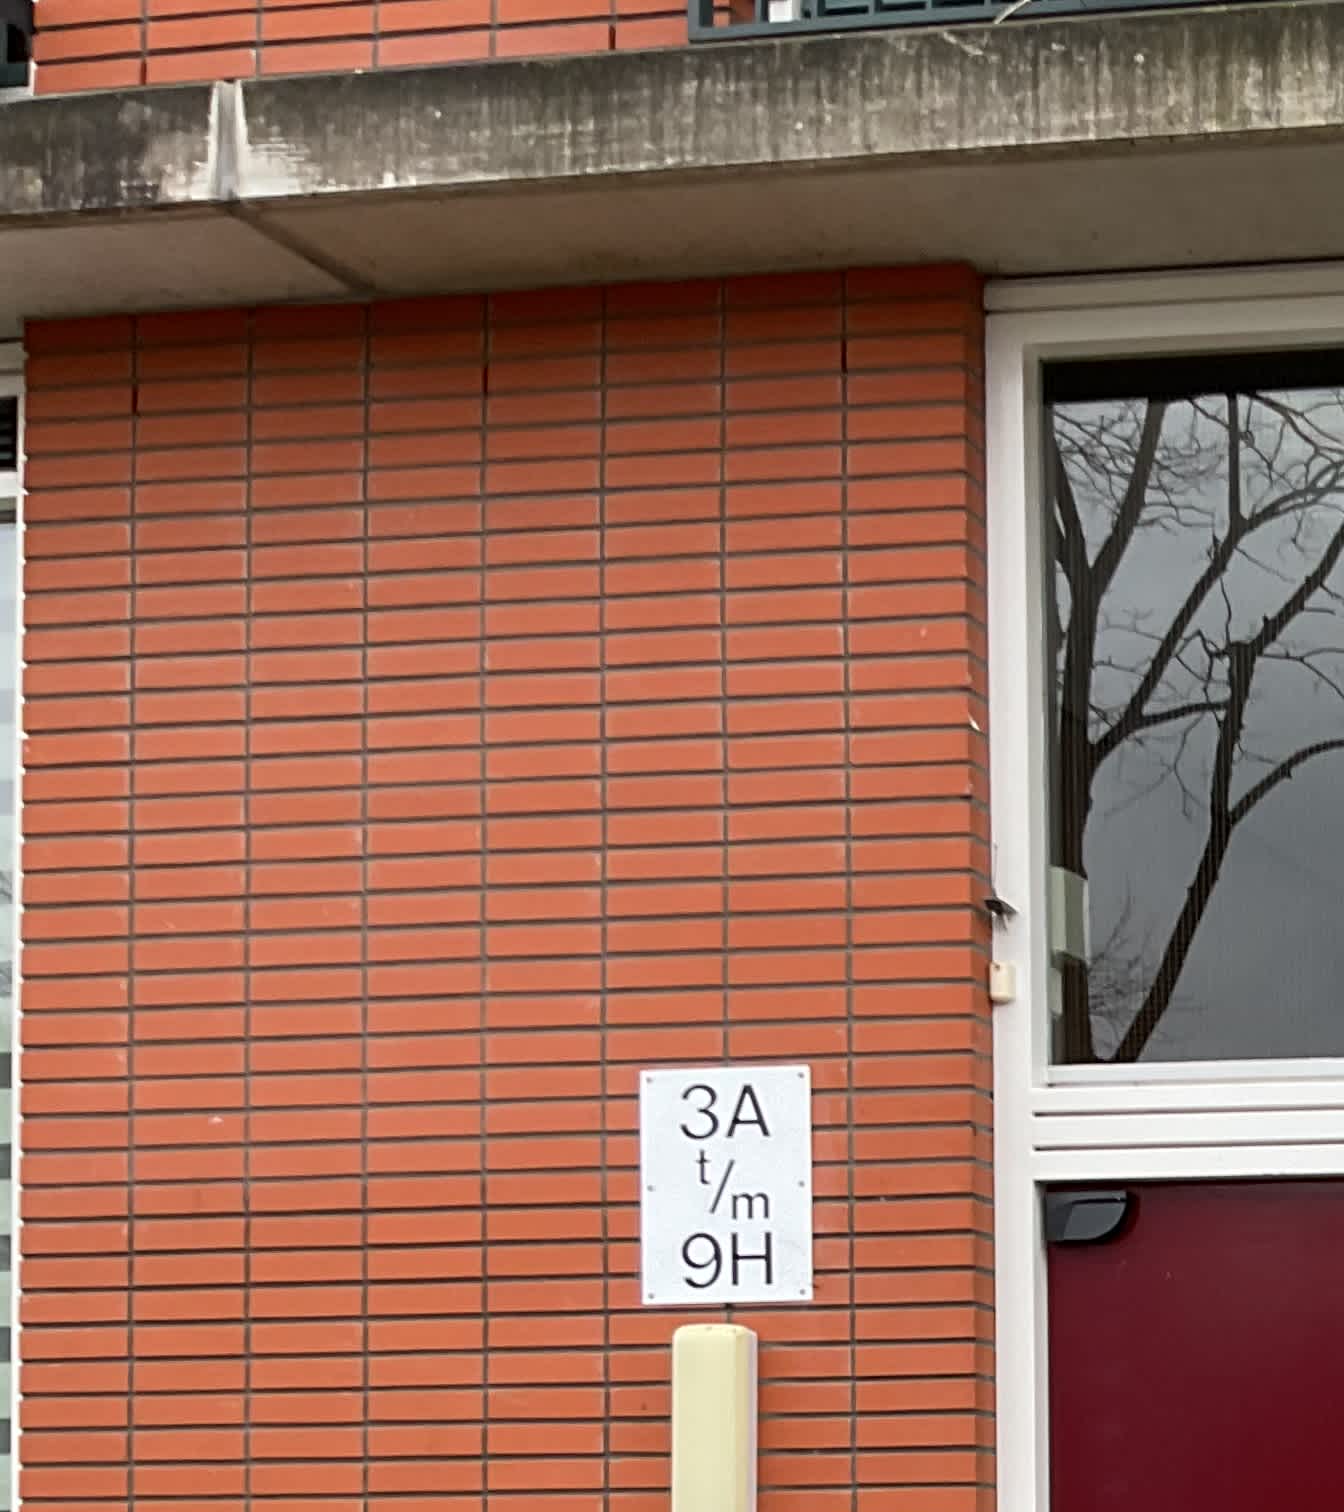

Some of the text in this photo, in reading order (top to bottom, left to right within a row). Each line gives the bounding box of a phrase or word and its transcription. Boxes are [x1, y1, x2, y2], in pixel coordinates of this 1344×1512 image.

[680, 1084, 770, 1140] 3A
[696, 1149, 770, 1219] t/m
[681, 1231, 773, 1289] 9H
